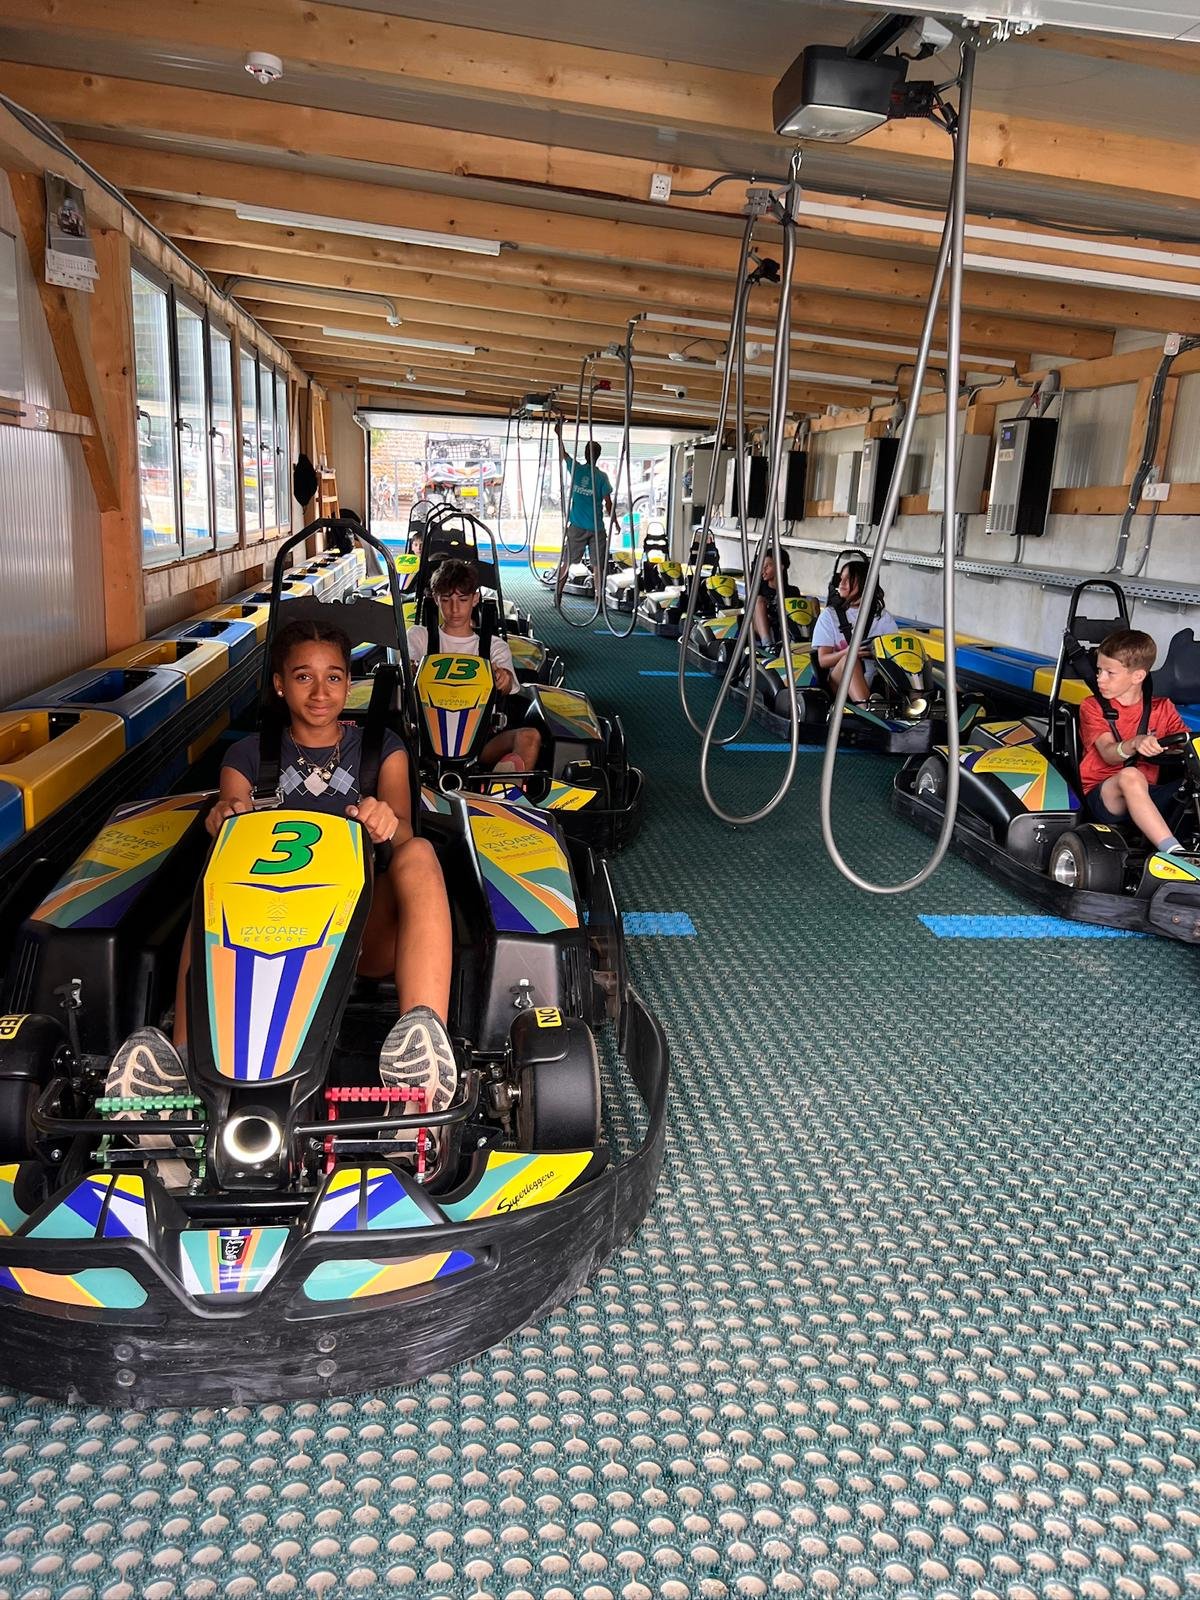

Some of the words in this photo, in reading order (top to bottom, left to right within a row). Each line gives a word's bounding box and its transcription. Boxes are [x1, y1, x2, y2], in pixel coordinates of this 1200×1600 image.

[789, 599, 807, 610] 10
[891, 636, 914, 650] 11
[431, 657, 480, 680] 13
[249, 820, 323, 875] 3
[480, 833, 544, 850] IZVOARE
[240, 926, 309, 936] IZVOARE
